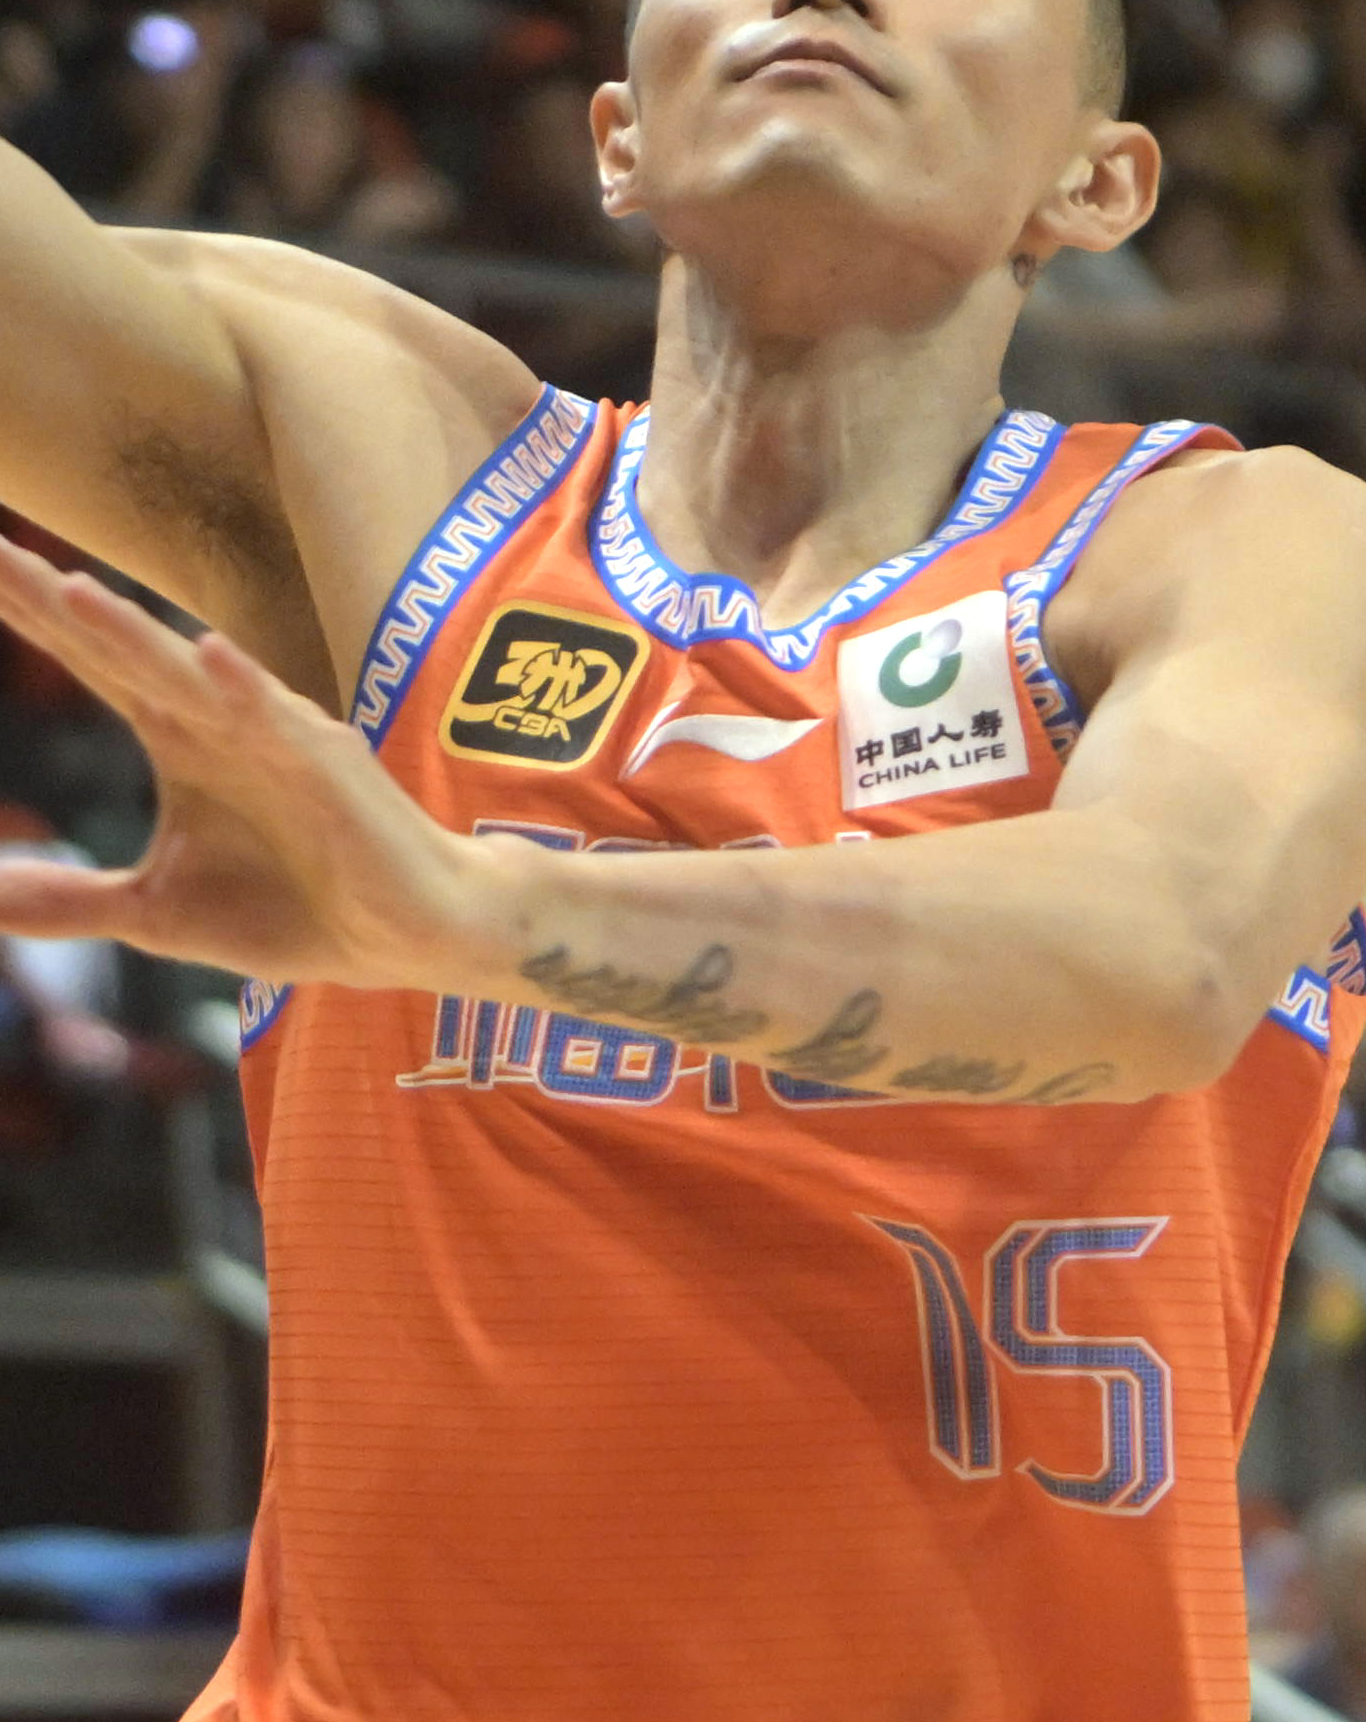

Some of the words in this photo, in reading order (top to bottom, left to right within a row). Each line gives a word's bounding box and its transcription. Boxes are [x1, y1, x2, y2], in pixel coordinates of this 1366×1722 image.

[493, 706, 571, 742] CBA
[855, 709, 1003, 767] 中国人寿
[858, 757, 940, 789] CHINA
[949, 743, 1007, 768] LIFE
[852, 1212, 1175, 1516] 15
